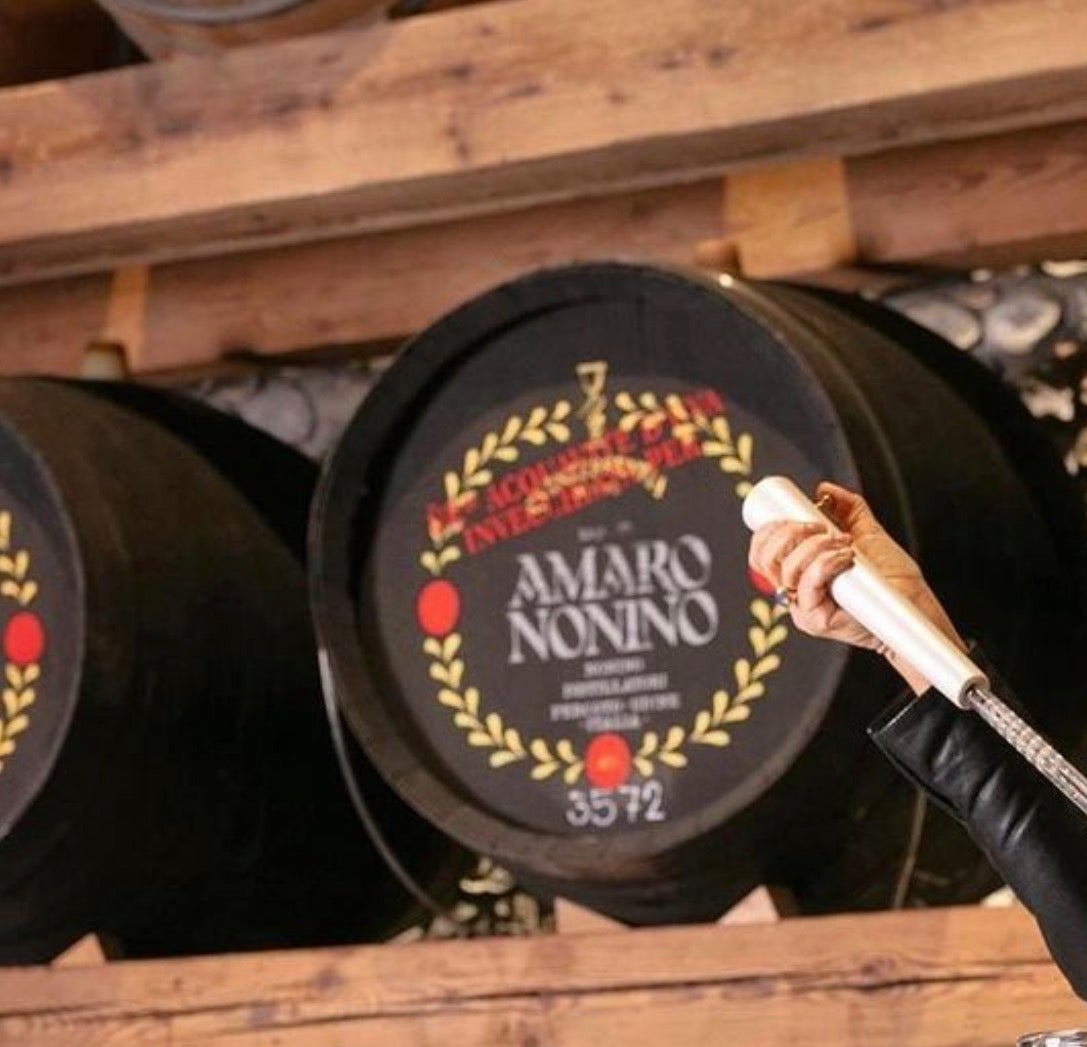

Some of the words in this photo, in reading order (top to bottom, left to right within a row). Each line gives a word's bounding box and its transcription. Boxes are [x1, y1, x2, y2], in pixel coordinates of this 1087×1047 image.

[508, 533, 712, 609] AMARO
[506, 589, 719, 664] NONINO
[566, 780, 666, 827] 3572
